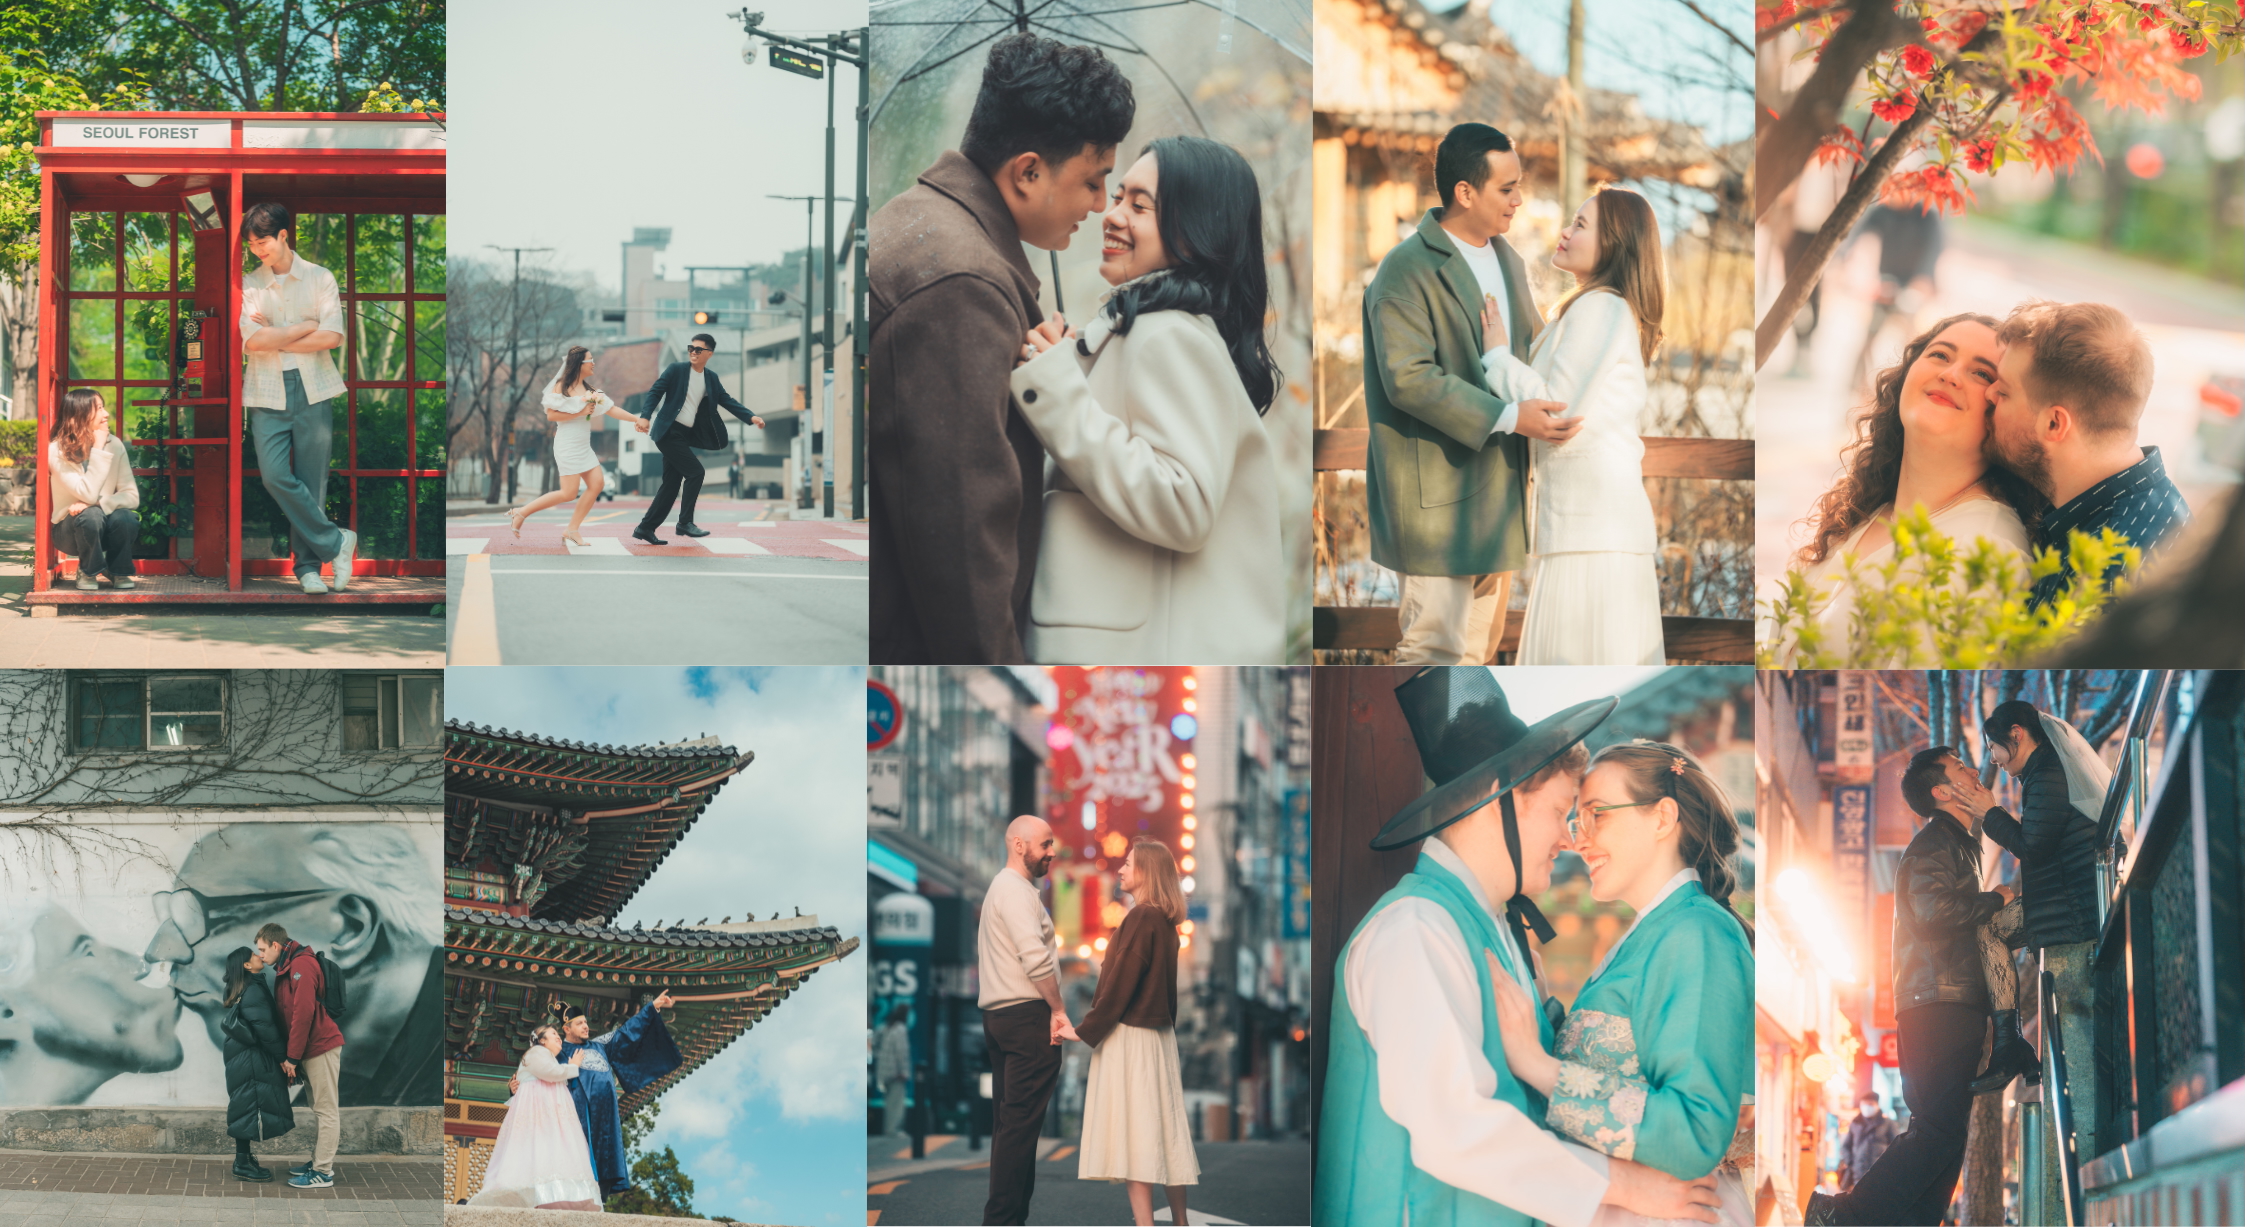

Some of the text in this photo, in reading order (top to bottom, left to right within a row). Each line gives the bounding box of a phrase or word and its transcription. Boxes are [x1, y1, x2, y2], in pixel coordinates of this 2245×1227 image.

[83, 127, 199, 140] SEOUL FOREST
[874, 960, 919, 997] GS
